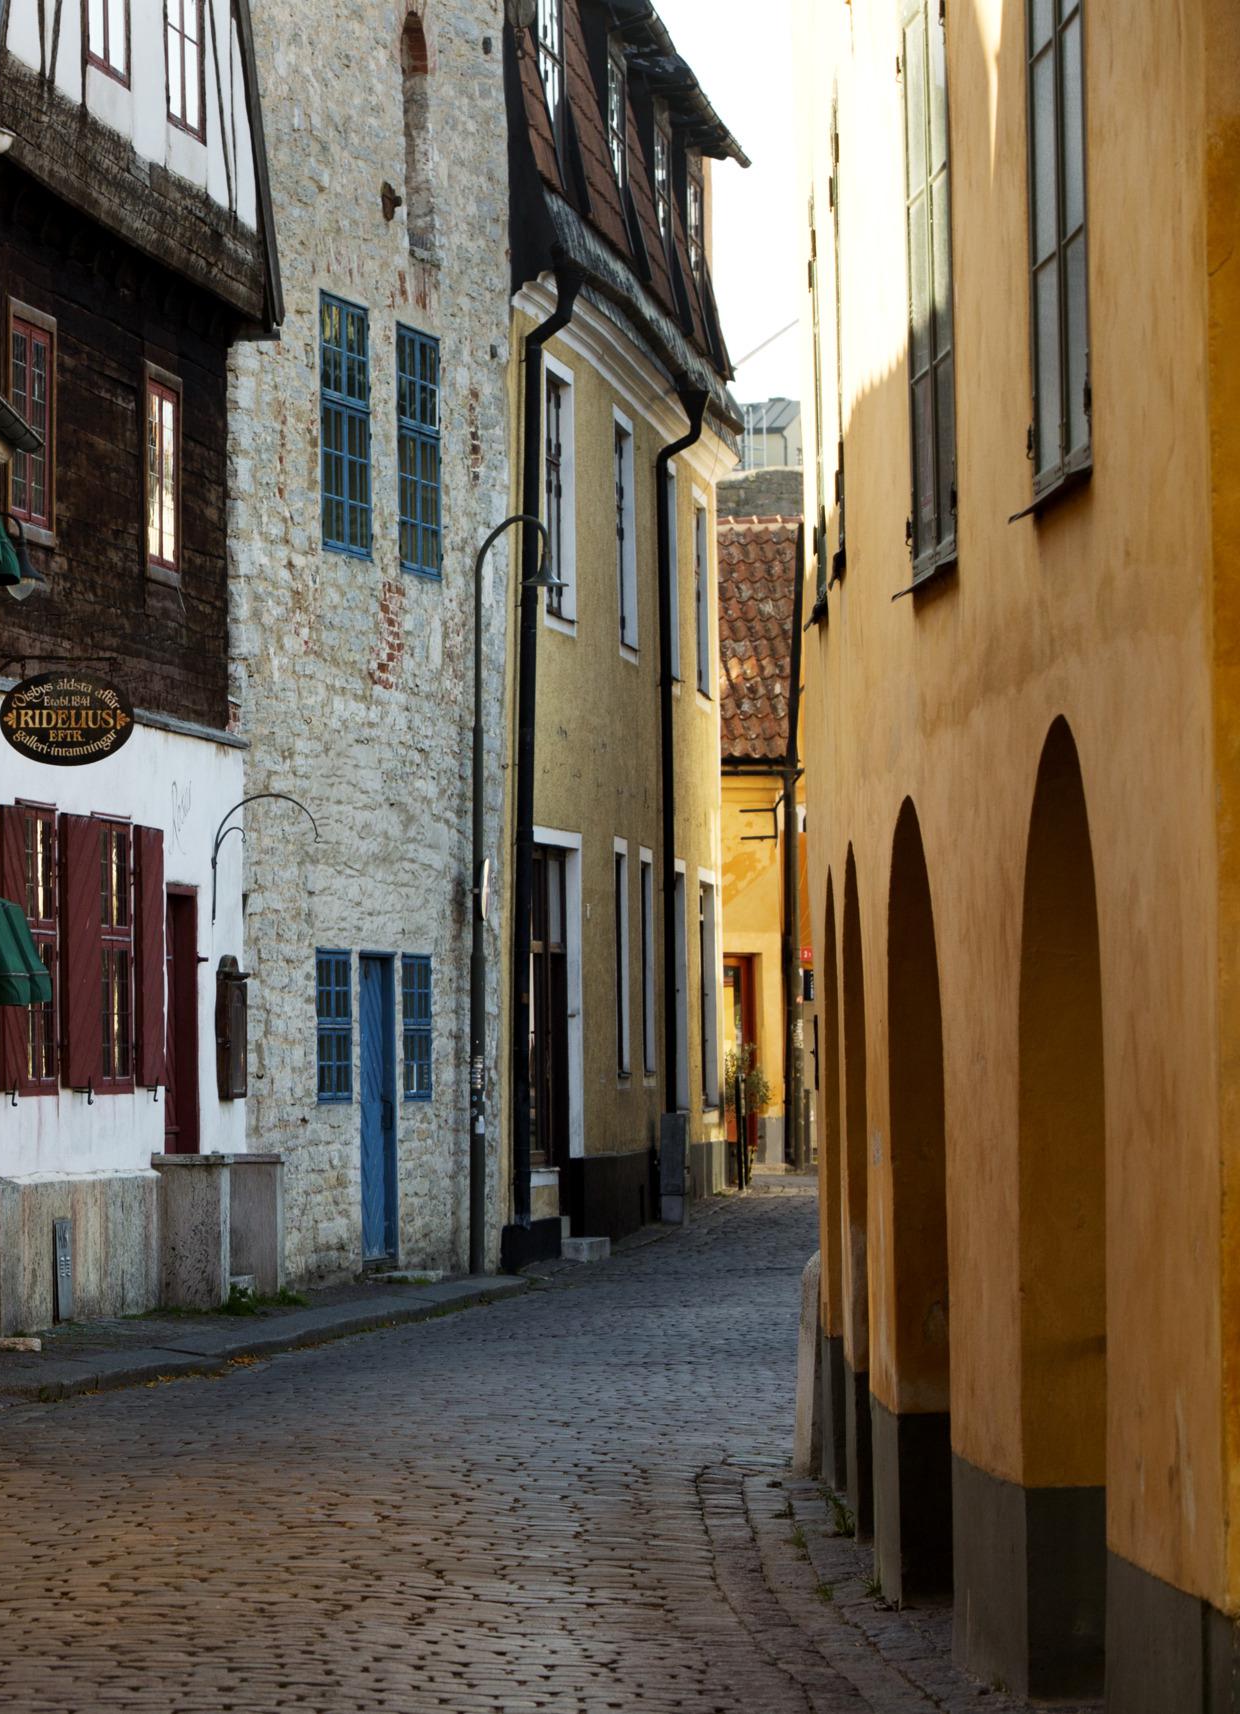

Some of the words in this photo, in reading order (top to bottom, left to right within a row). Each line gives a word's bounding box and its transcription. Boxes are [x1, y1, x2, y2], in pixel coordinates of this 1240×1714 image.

[12, 682, 53, 708] Visbys
[56, 678, 93, 693] äldsta
[95, 688, 120, 709] affär
[19, 709, 114, 728] RIDELIUS
[49, 730, 85, 742] EFTR.
